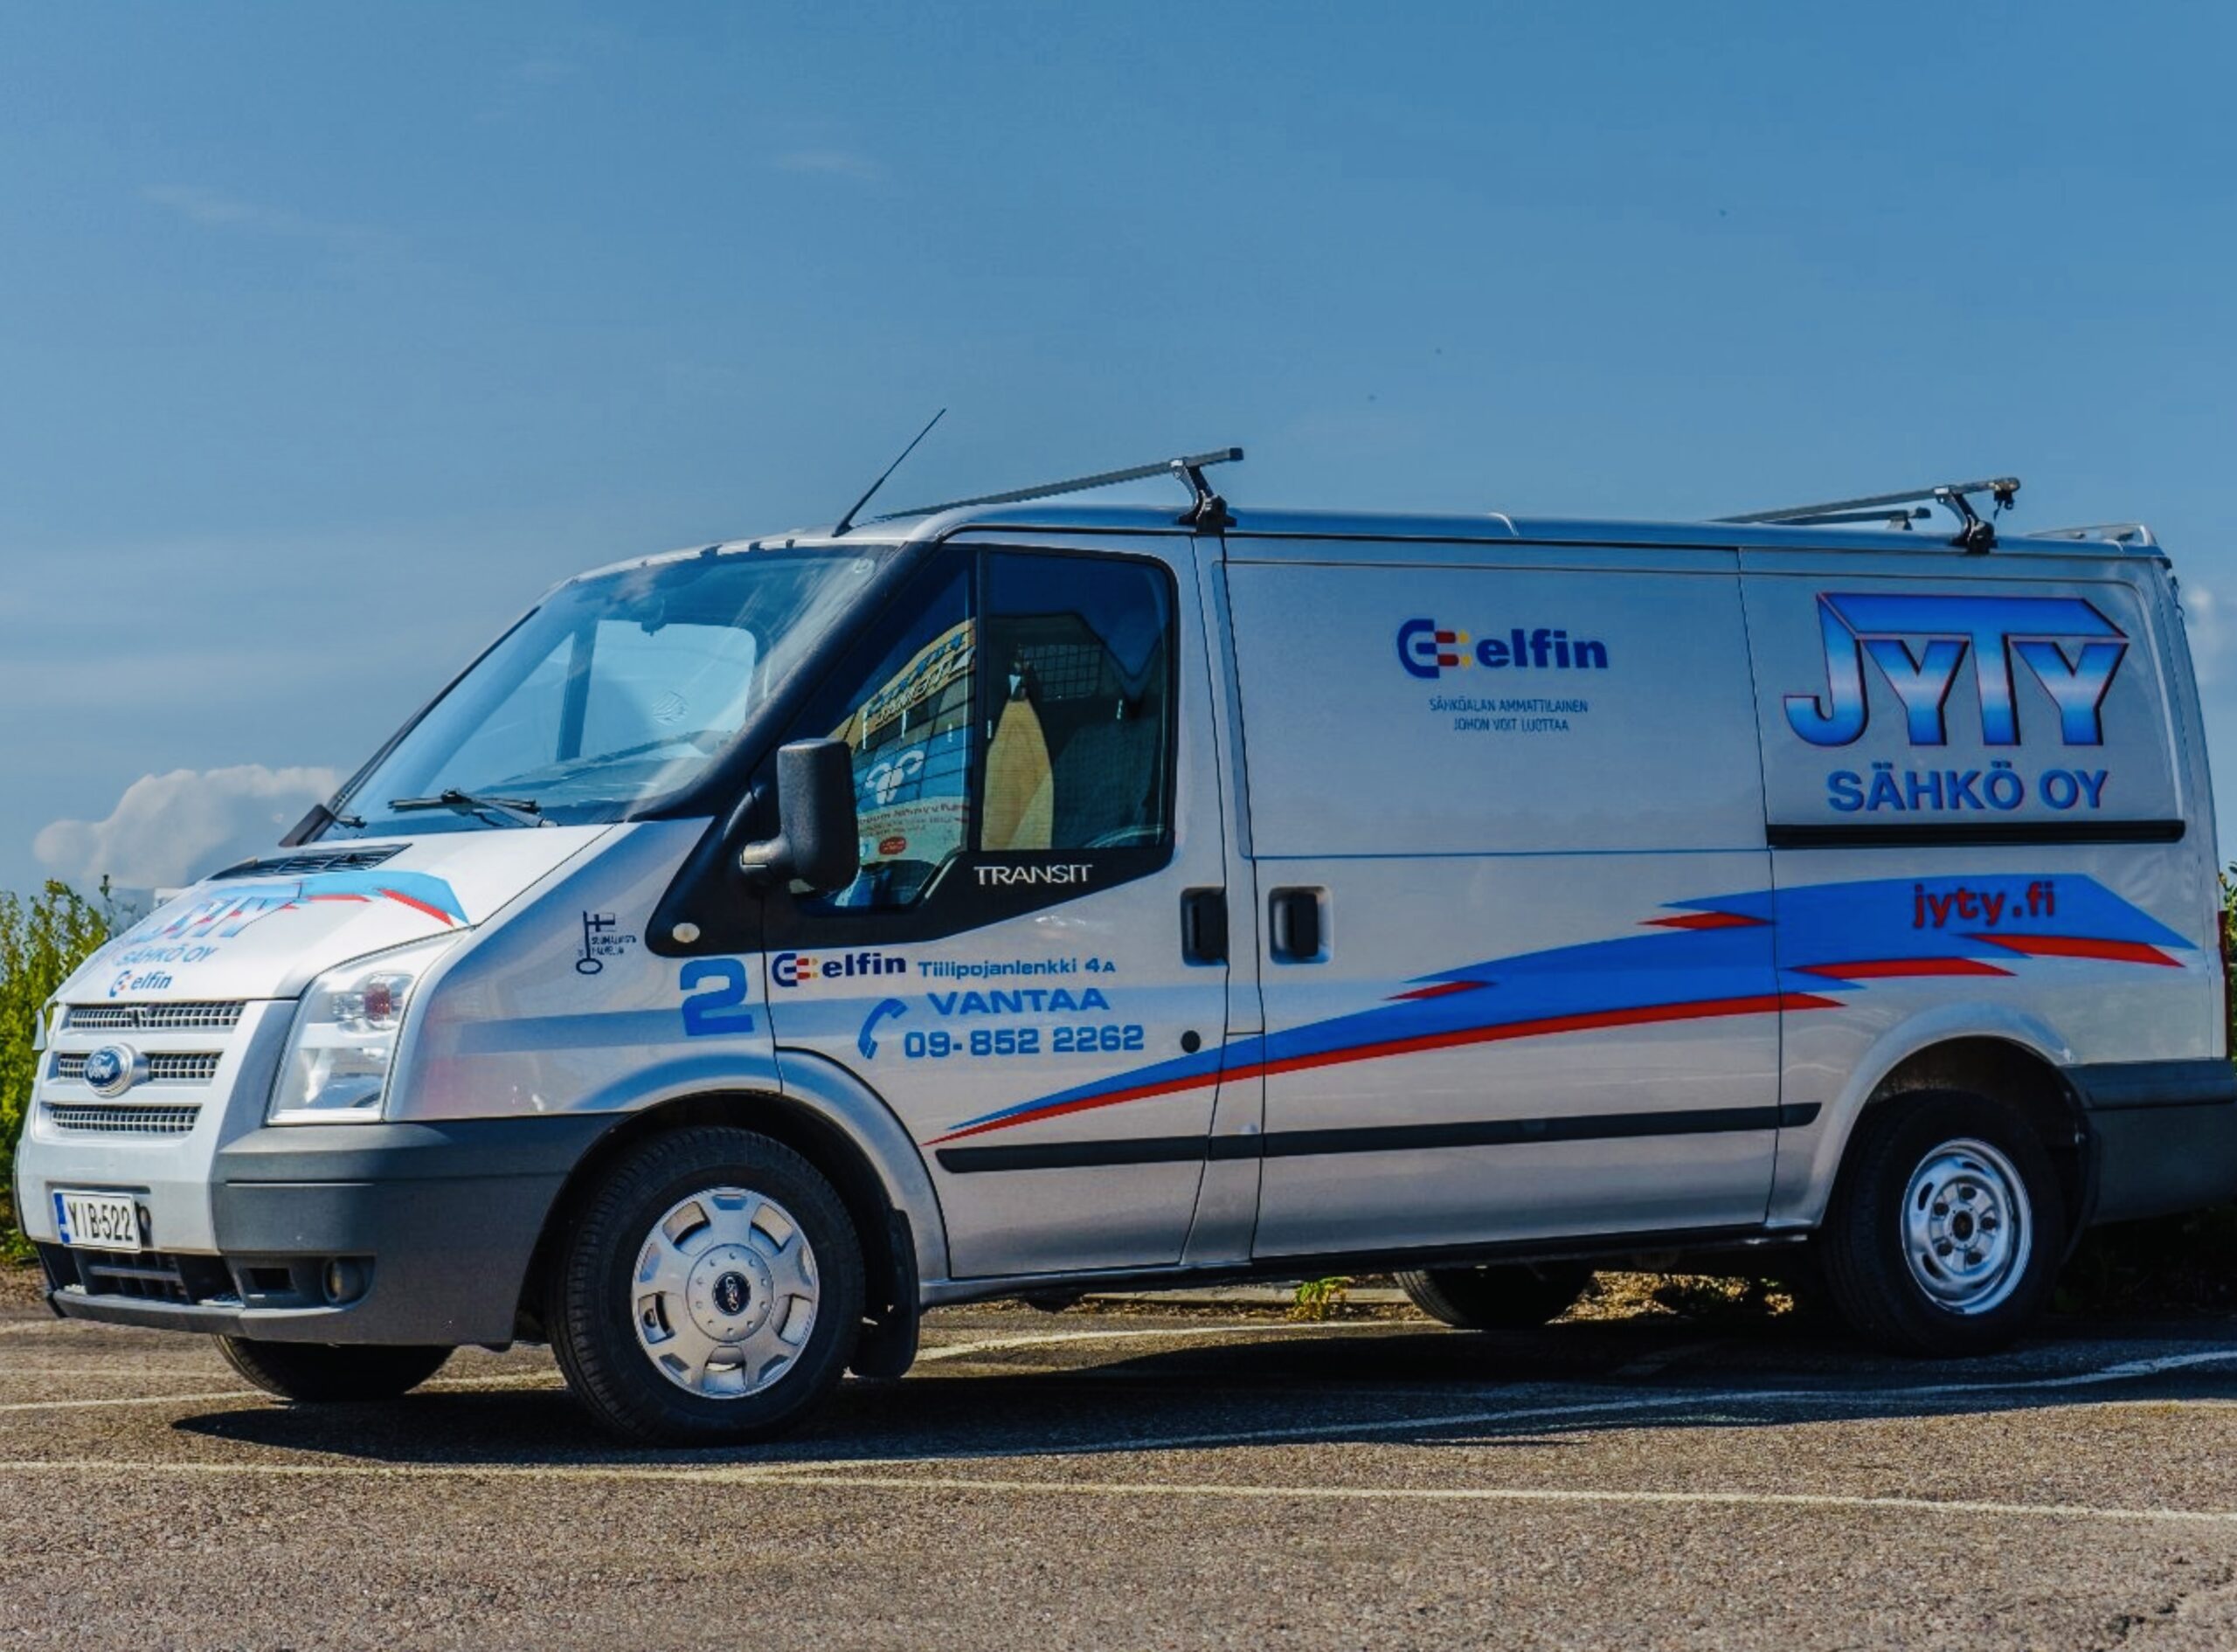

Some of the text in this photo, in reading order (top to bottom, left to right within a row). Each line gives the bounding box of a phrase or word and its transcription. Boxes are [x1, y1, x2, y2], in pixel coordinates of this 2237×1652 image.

[1476, 629, 1609, 668] elfin
[1783, 592, 2129, 747] JYTY
[1429, 695, 1496, 712] SÄHKÖALAN
[1454, 717, 1489, 731] JOHON
[1492, 717, 1518, 731] VOIT
[1827, 761, 2108, 812] SÄHKÖ OY
[973, 864, 1093, 885] TRANSIT
[1914, 881, 2053, 928] jyty.fi
[822, 953, 906, 978] elfin
[918, 958, 1077, 979] Tiilipojanlenkki
[130, 971, 172, 990] elfin
[680, 958, 754, 1036] 2
[927, 988, 1110, 1015] VANTAA
[1053, 1025, 1144, 1052] 2262
[67, 1202, 133, 1241] YIB-522
